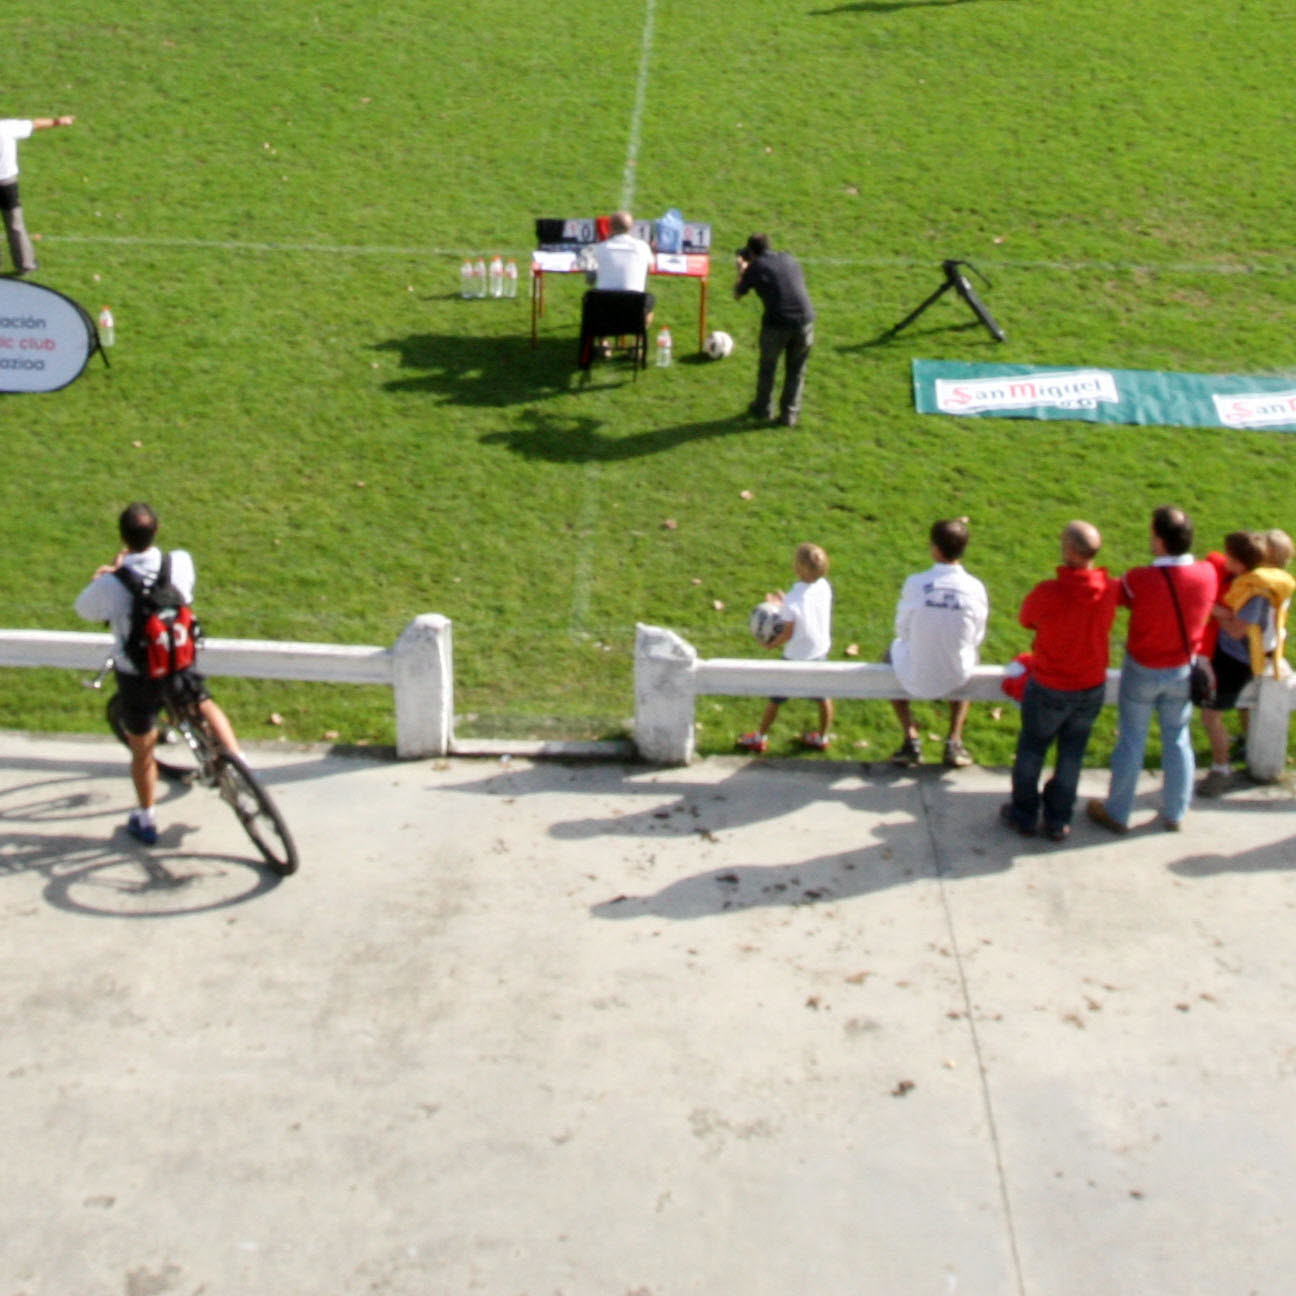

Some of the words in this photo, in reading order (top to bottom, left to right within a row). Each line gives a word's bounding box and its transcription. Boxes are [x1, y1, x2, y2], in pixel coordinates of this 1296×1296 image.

[19, 335, 56, 350] club
[944, 386, 1004, 407] San
[1007, 378, 1102, 400] Miguel
